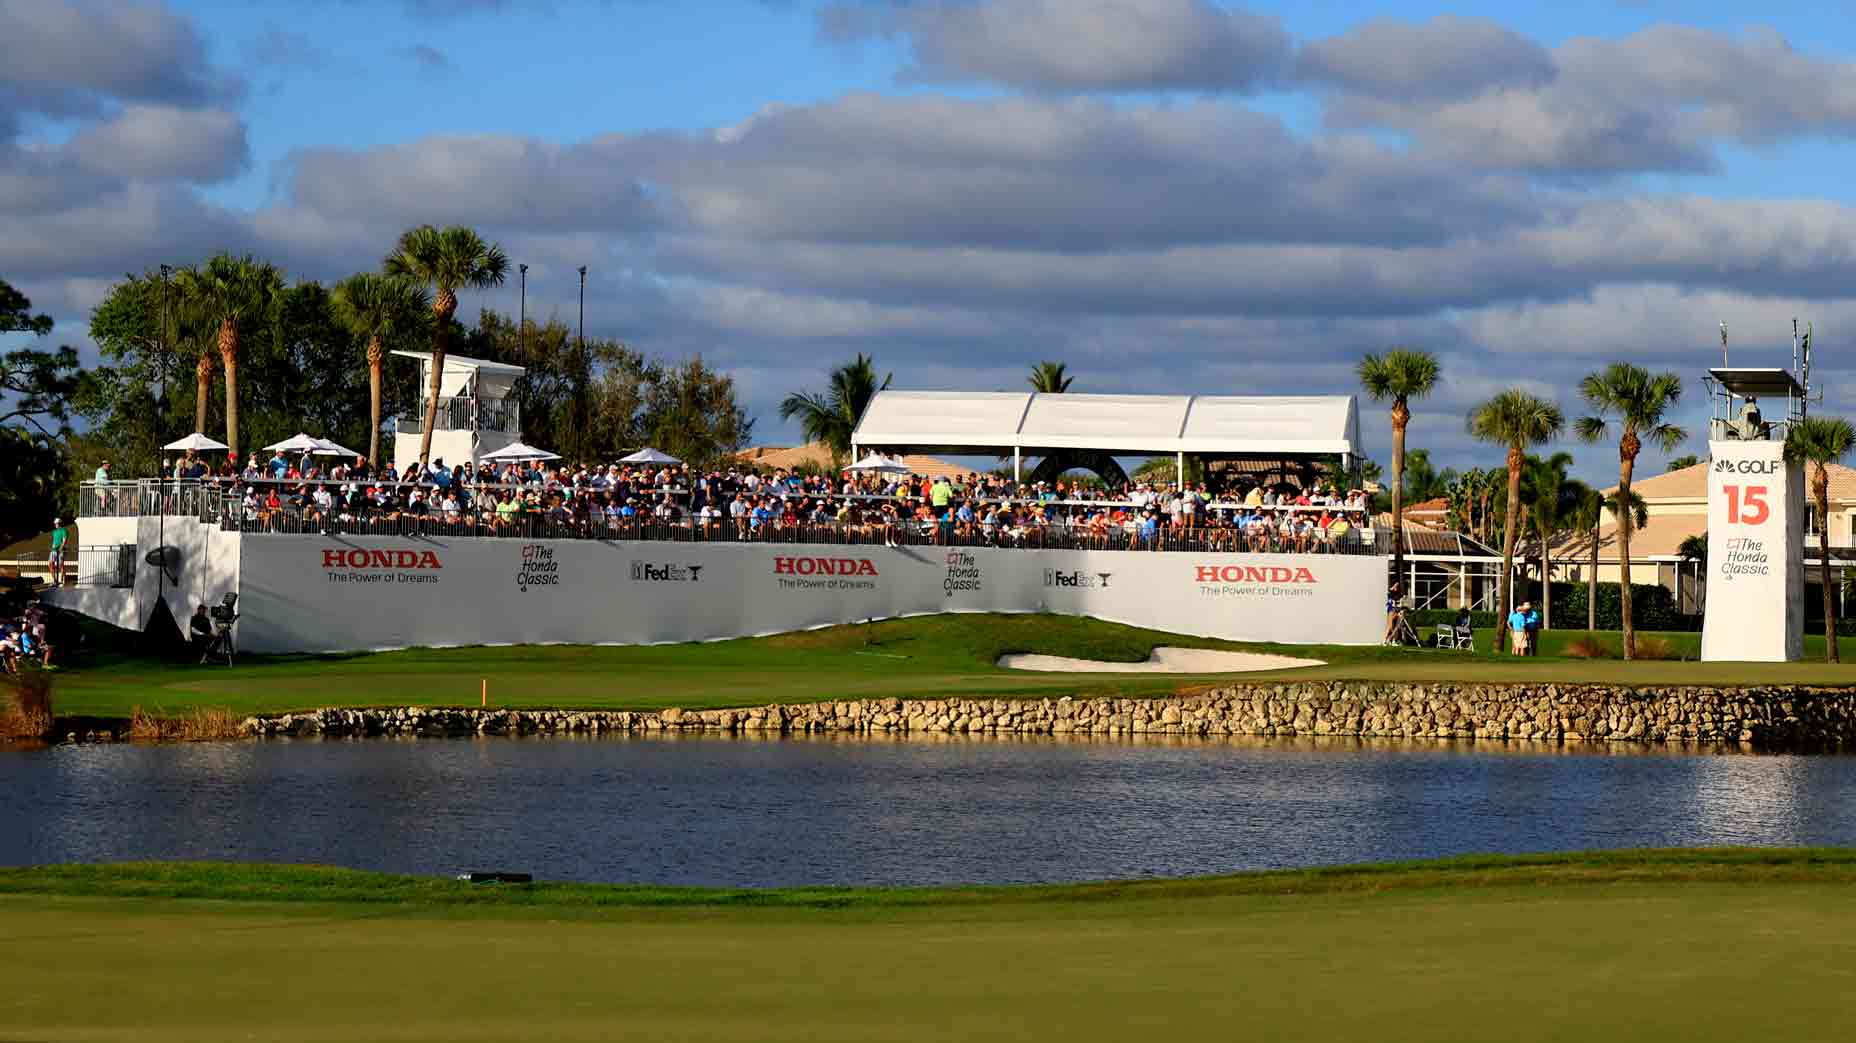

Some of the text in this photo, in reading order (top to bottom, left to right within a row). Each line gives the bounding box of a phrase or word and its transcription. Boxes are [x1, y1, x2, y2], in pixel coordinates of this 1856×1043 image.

[1737, 460, 1779, 474] GOLF
[1722, 485, 1770, 525] 15
[1742, 538, 1763, 550] The
[321, 549, 443, 568] HONDA
[534, 545, 553, 559] The
[1727, 551, 1768, 563] Honda
[522, 560, 558, 572] Honda
[958, 553, 975, 566] The
[774, 557, 878, 576] HONDA
[948, 567, 979, 578] Honda
[1721, 563, 1769, 575] Classic
[327, 573, 438, 583] The Power of Dreams
[517, 573, 558, 586] Classic
[1194, 566, 1317, 583] HONDA
[778, 579, 875, 590] The Power of Dreams
[943, 578, 981, 591] Classic
[1222, 586, 1255, 596] Power
[1258, 587, 1269, 597] of
